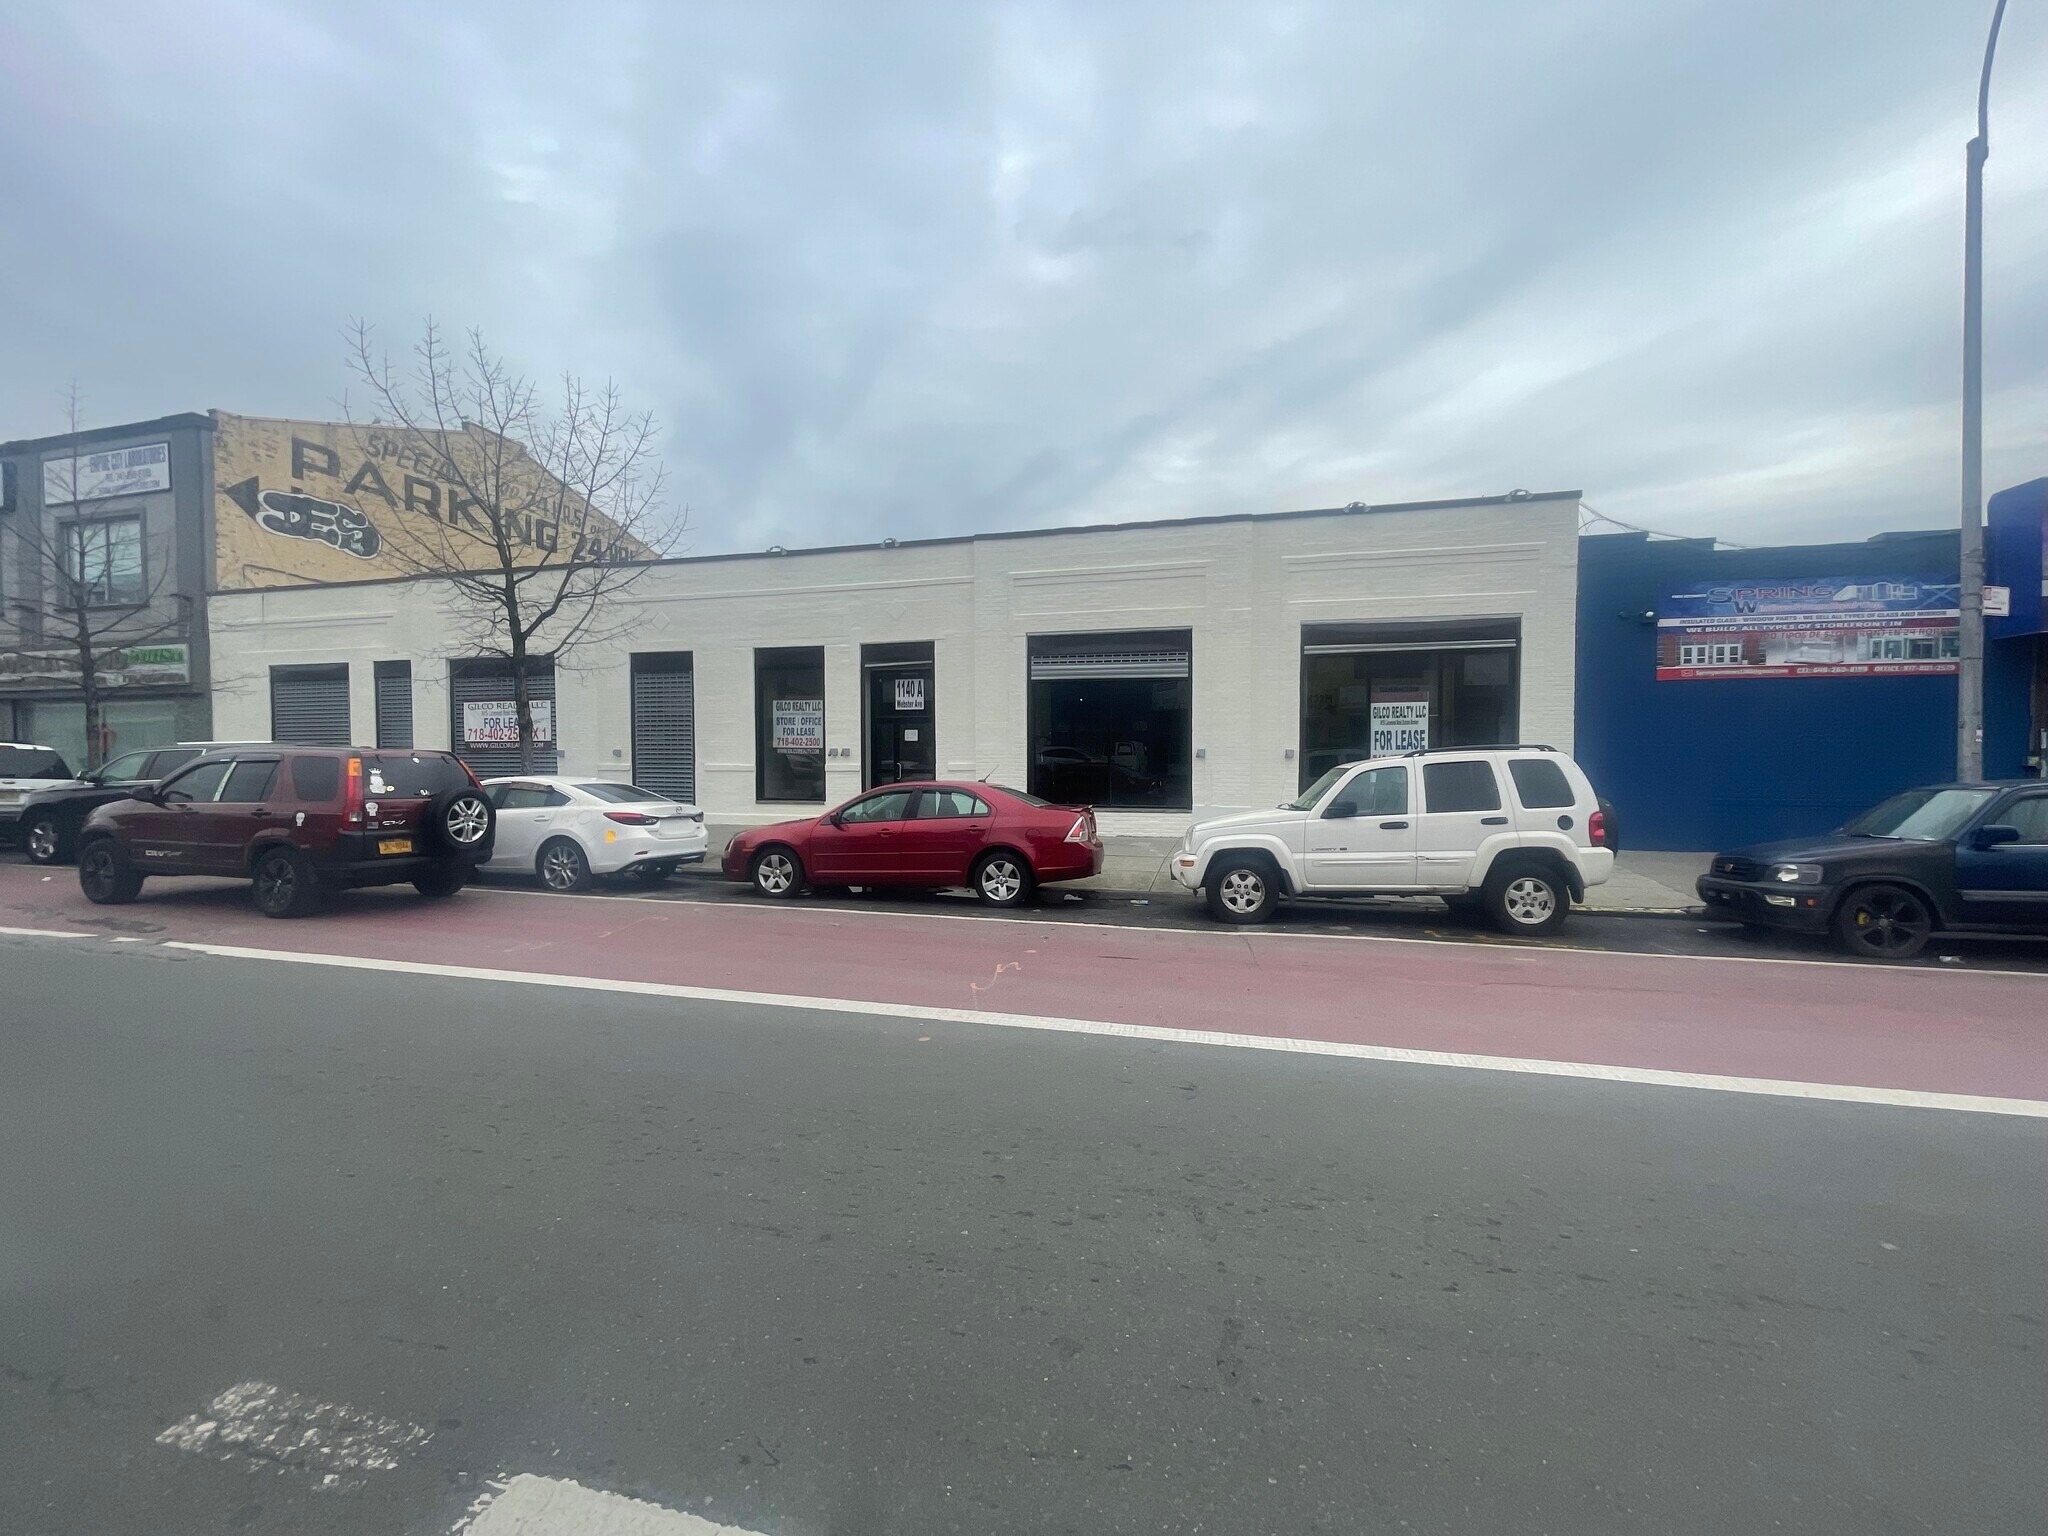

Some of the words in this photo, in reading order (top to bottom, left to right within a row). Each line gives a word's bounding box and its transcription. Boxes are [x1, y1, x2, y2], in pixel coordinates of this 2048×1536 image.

[1706, 586, 1833, 604] SPRING
[897, 680, 915, 698] 1140
[917, 680, 923, 698] A
[467, 702, 494, 710] GILCO
[776, 701, 792, 711] GILCO
[792, 701, 811, 711] REALTY
[897, 700, 914, 708] Webster
[915, 699, 923, 708] Ave
[1372, 706, 1390, 719] GILCO
[1391, 705, 1414, 718] REALTY
[1415, 705, 1426, 718] LLC
[483, 717, 501, 728] FOR
[776, 717, 796, 726] STORE
[800, 717, 822, 726] OFFICE
[782, 727, 795, 736] FOR
[796, 727, 816, 736] LEASE
[777, 737, 820, 746] 718-402-2500
[1374, 730, 1393, 750] FOR
[1395, 730, 1426, 750] LEASE
